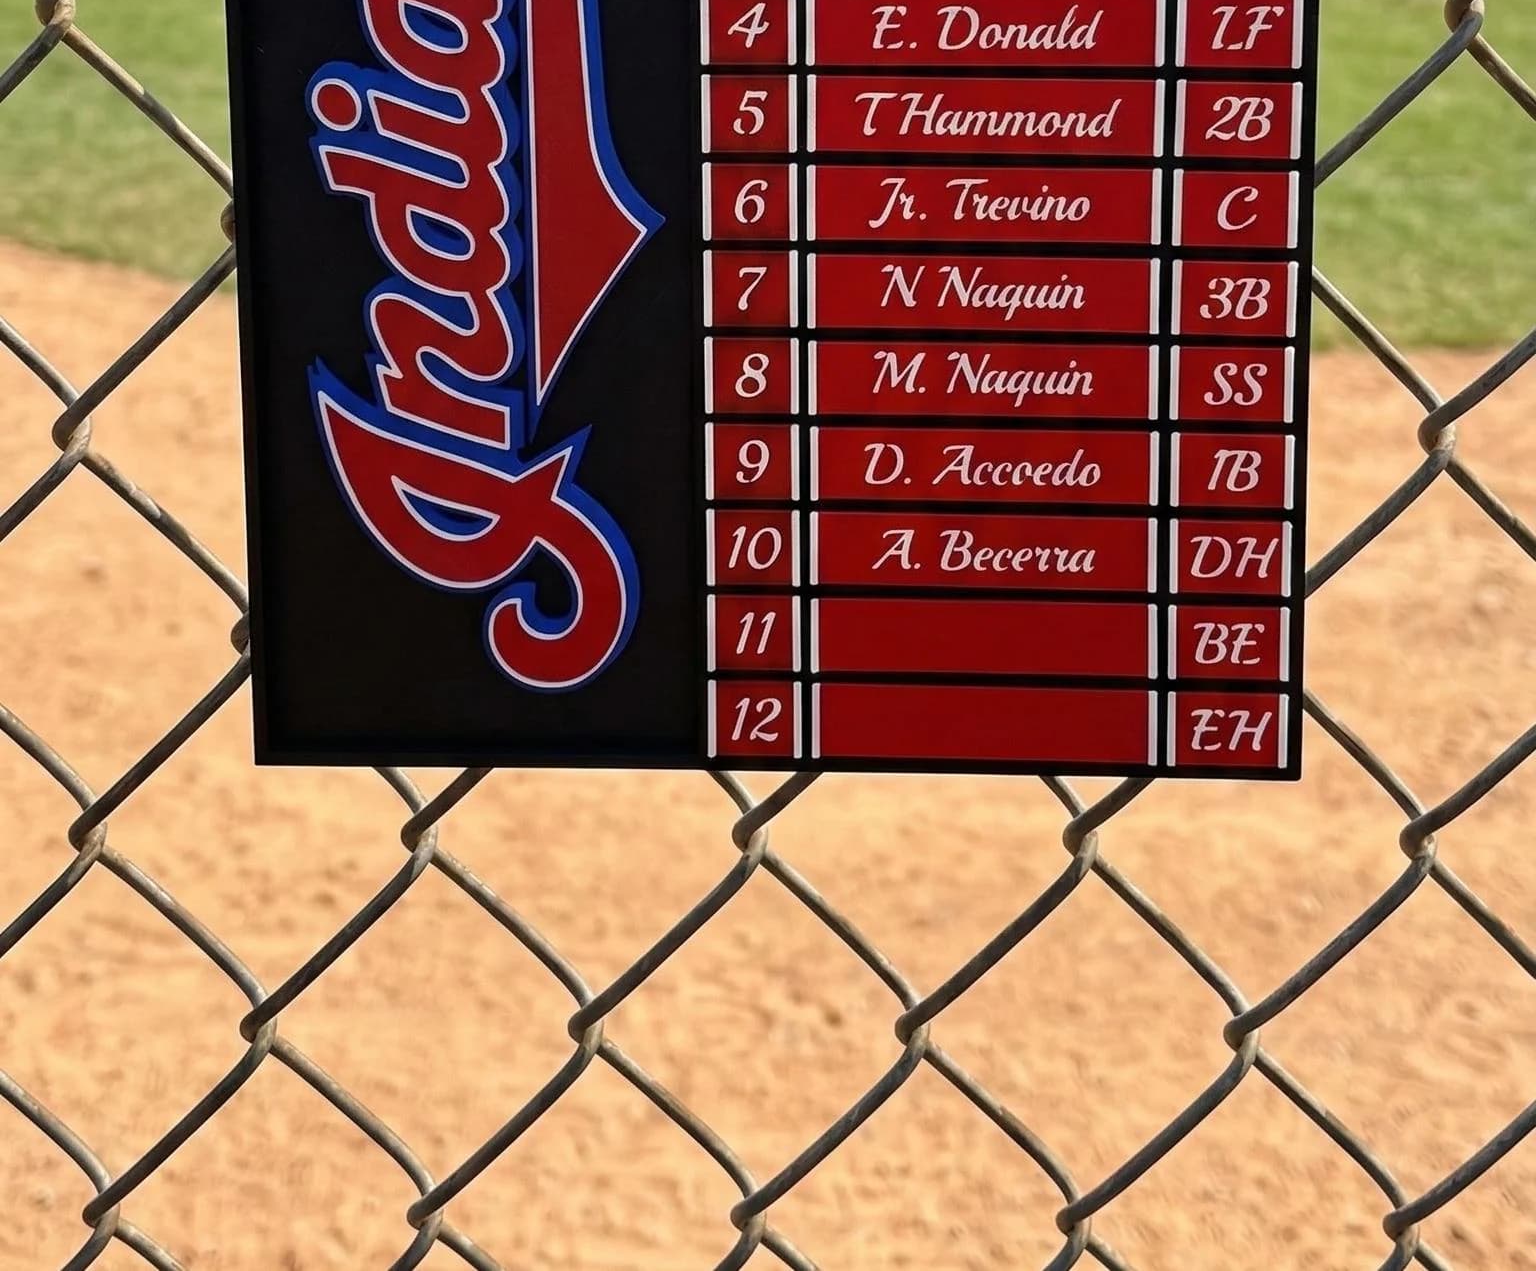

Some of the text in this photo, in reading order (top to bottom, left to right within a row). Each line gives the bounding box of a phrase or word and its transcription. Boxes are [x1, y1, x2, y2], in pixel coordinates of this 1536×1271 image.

[727, 2, 1285, 50] 4 E. Donald LF
[733, 90, 1274, 142] 5 T Hammond 2B
[734, 177, 1259, 231] 6 Jr. Trevino C
[737, 264, 1271, 321] 7 N Naquin 3B
[734, 350, 1268, 408] 8 M. Naquin SS
[735, 439, 770, 484] 9
[864, 442, 912, 485] D.
[728, 525, 1280, 579] 10 A. Becerra DH
[736, 611, 1265, 665] 11 BE
[731, 697, 1273, 752] 12 EH
